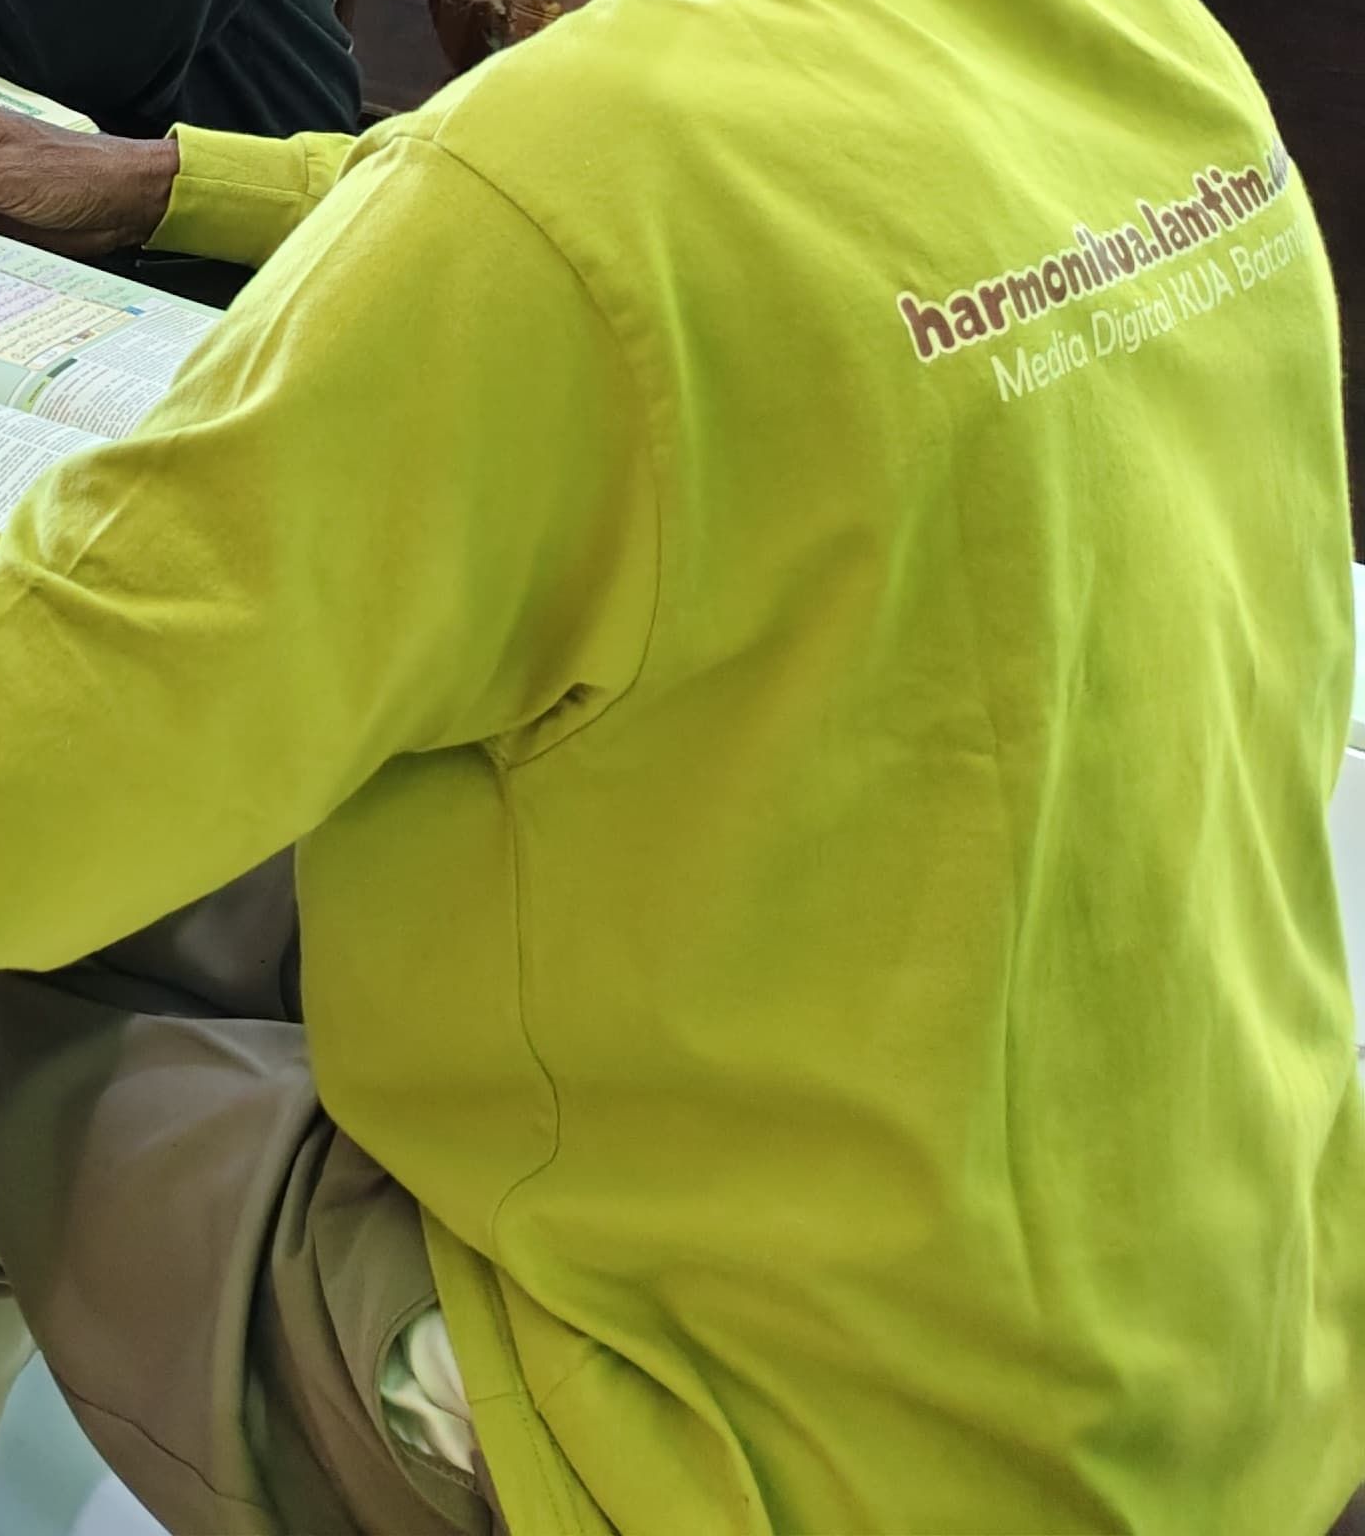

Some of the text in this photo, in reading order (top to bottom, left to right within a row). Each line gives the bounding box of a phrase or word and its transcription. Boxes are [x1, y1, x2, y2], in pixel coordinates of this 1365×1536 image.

[989, 333, 1091, 403] Media
[1091, 287, 1177, 357] Digital
[1168, 265, 1236, 322] KUA
